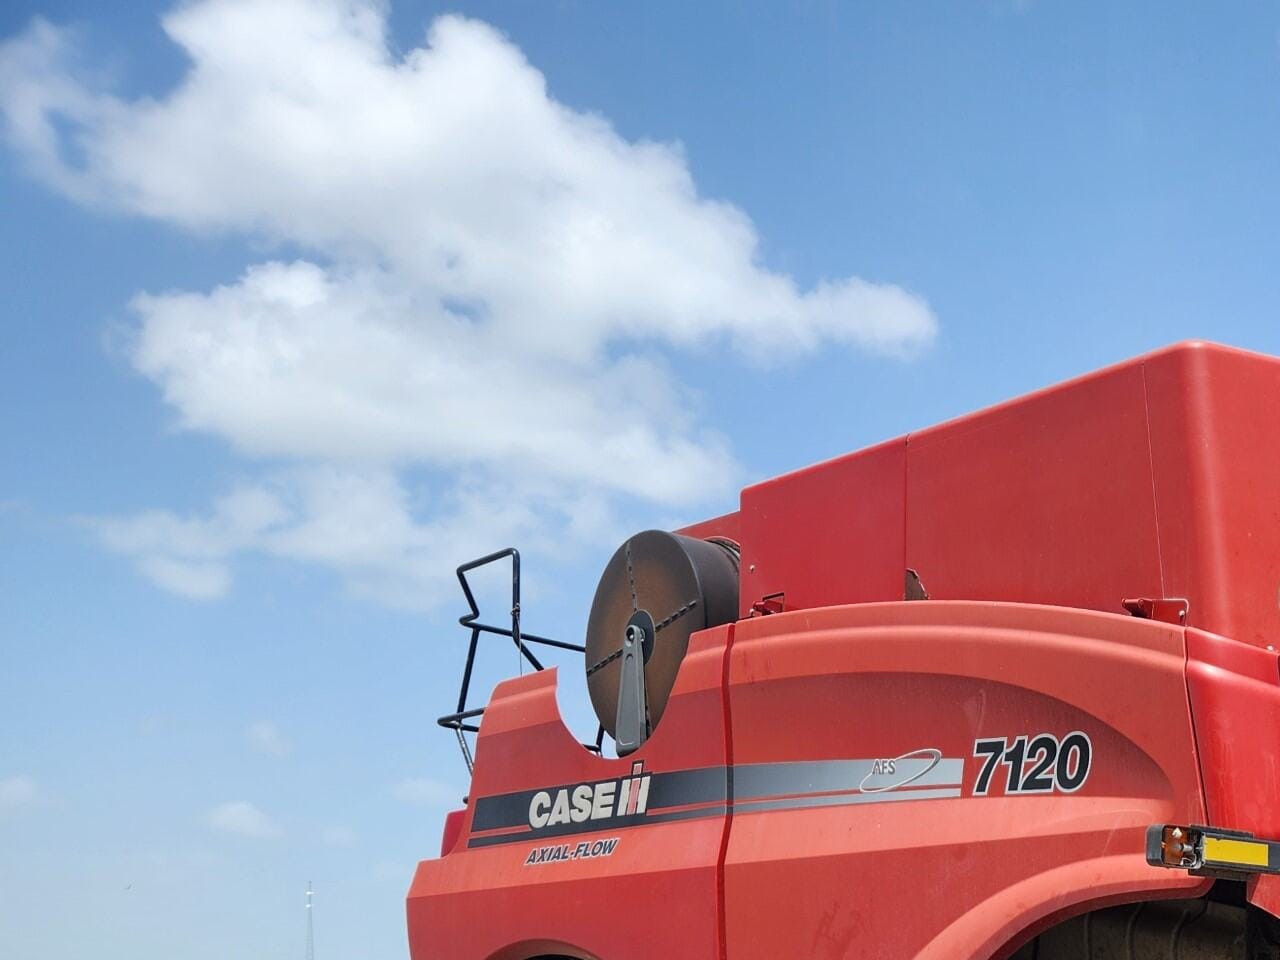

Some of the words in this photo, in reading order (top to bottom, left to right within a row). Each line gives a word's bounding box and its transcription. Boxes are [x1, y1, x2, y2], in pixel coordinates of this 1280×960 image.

[872, 759, 896, 775] AFS
[972, 731, 1092, 796] 7120
[528, 781, 617, 829] CASE
[524, 838, 620, 865] AXIAL-FLOW
